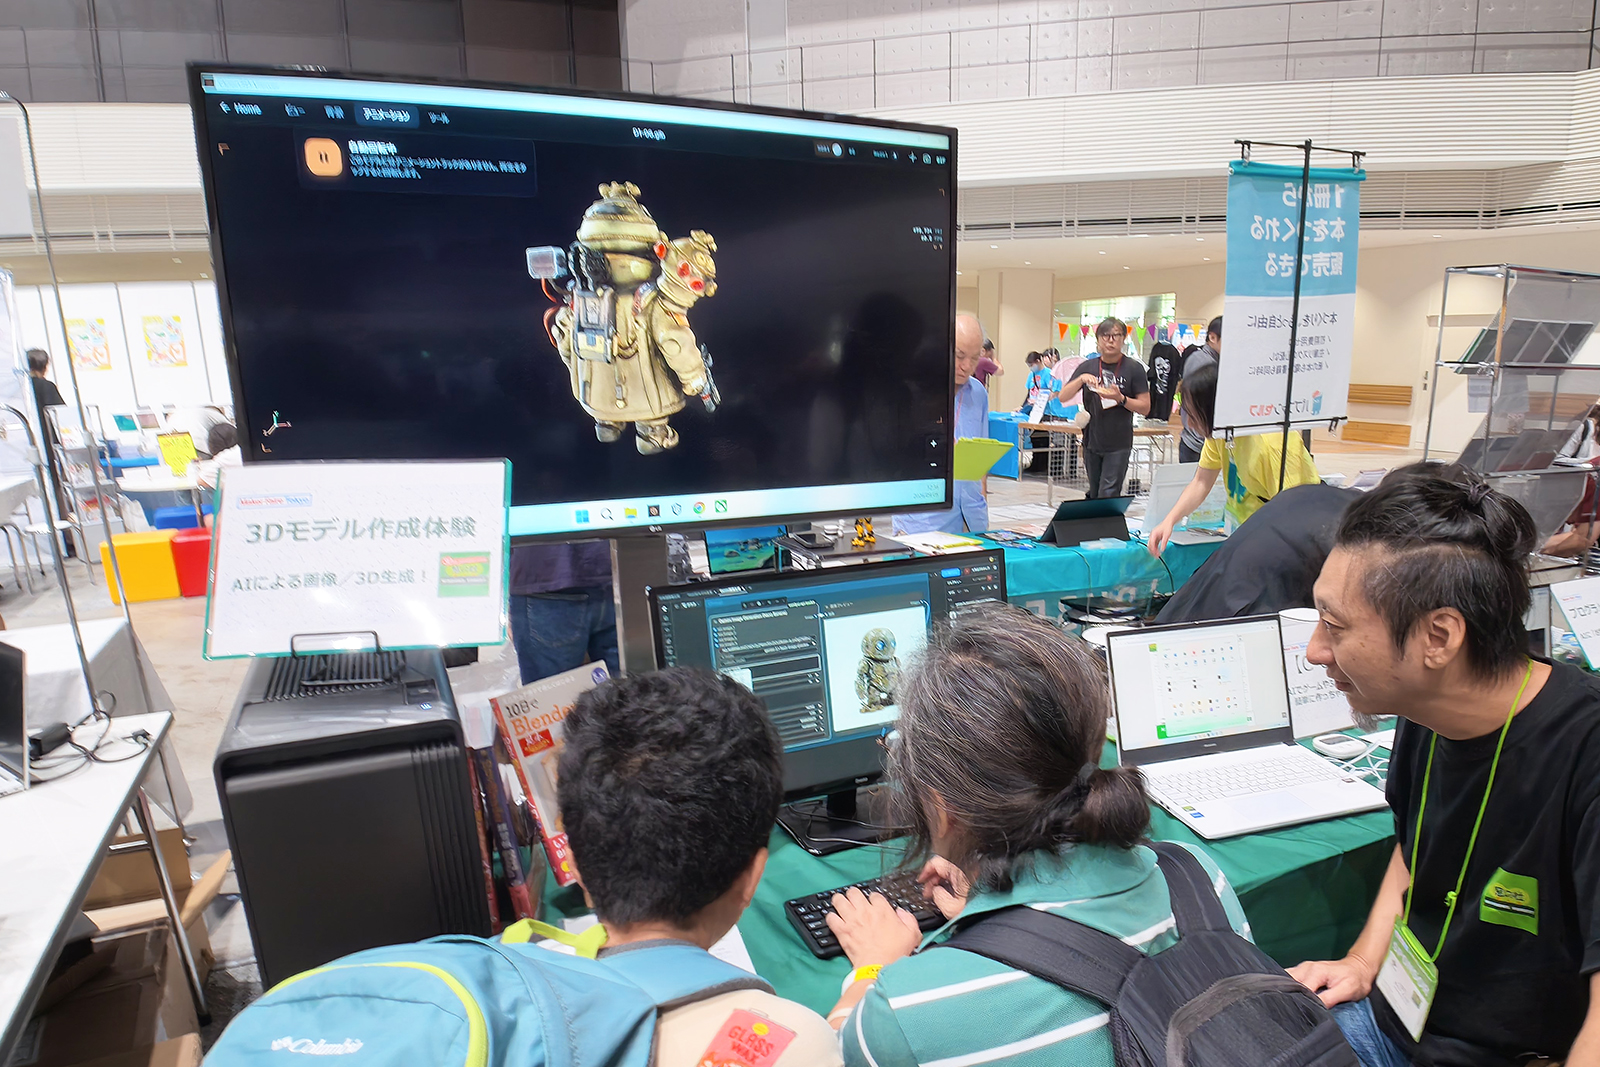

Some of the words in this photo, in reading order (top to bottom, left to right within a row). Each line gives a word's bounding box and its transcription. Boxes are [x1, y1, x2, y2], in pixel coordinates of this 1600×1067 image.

[233, 102, 263, 116] Home
[245, 515, 477, 545] 3Dモデル作成体験
[728, 1024, 774, 1058] GLASS
